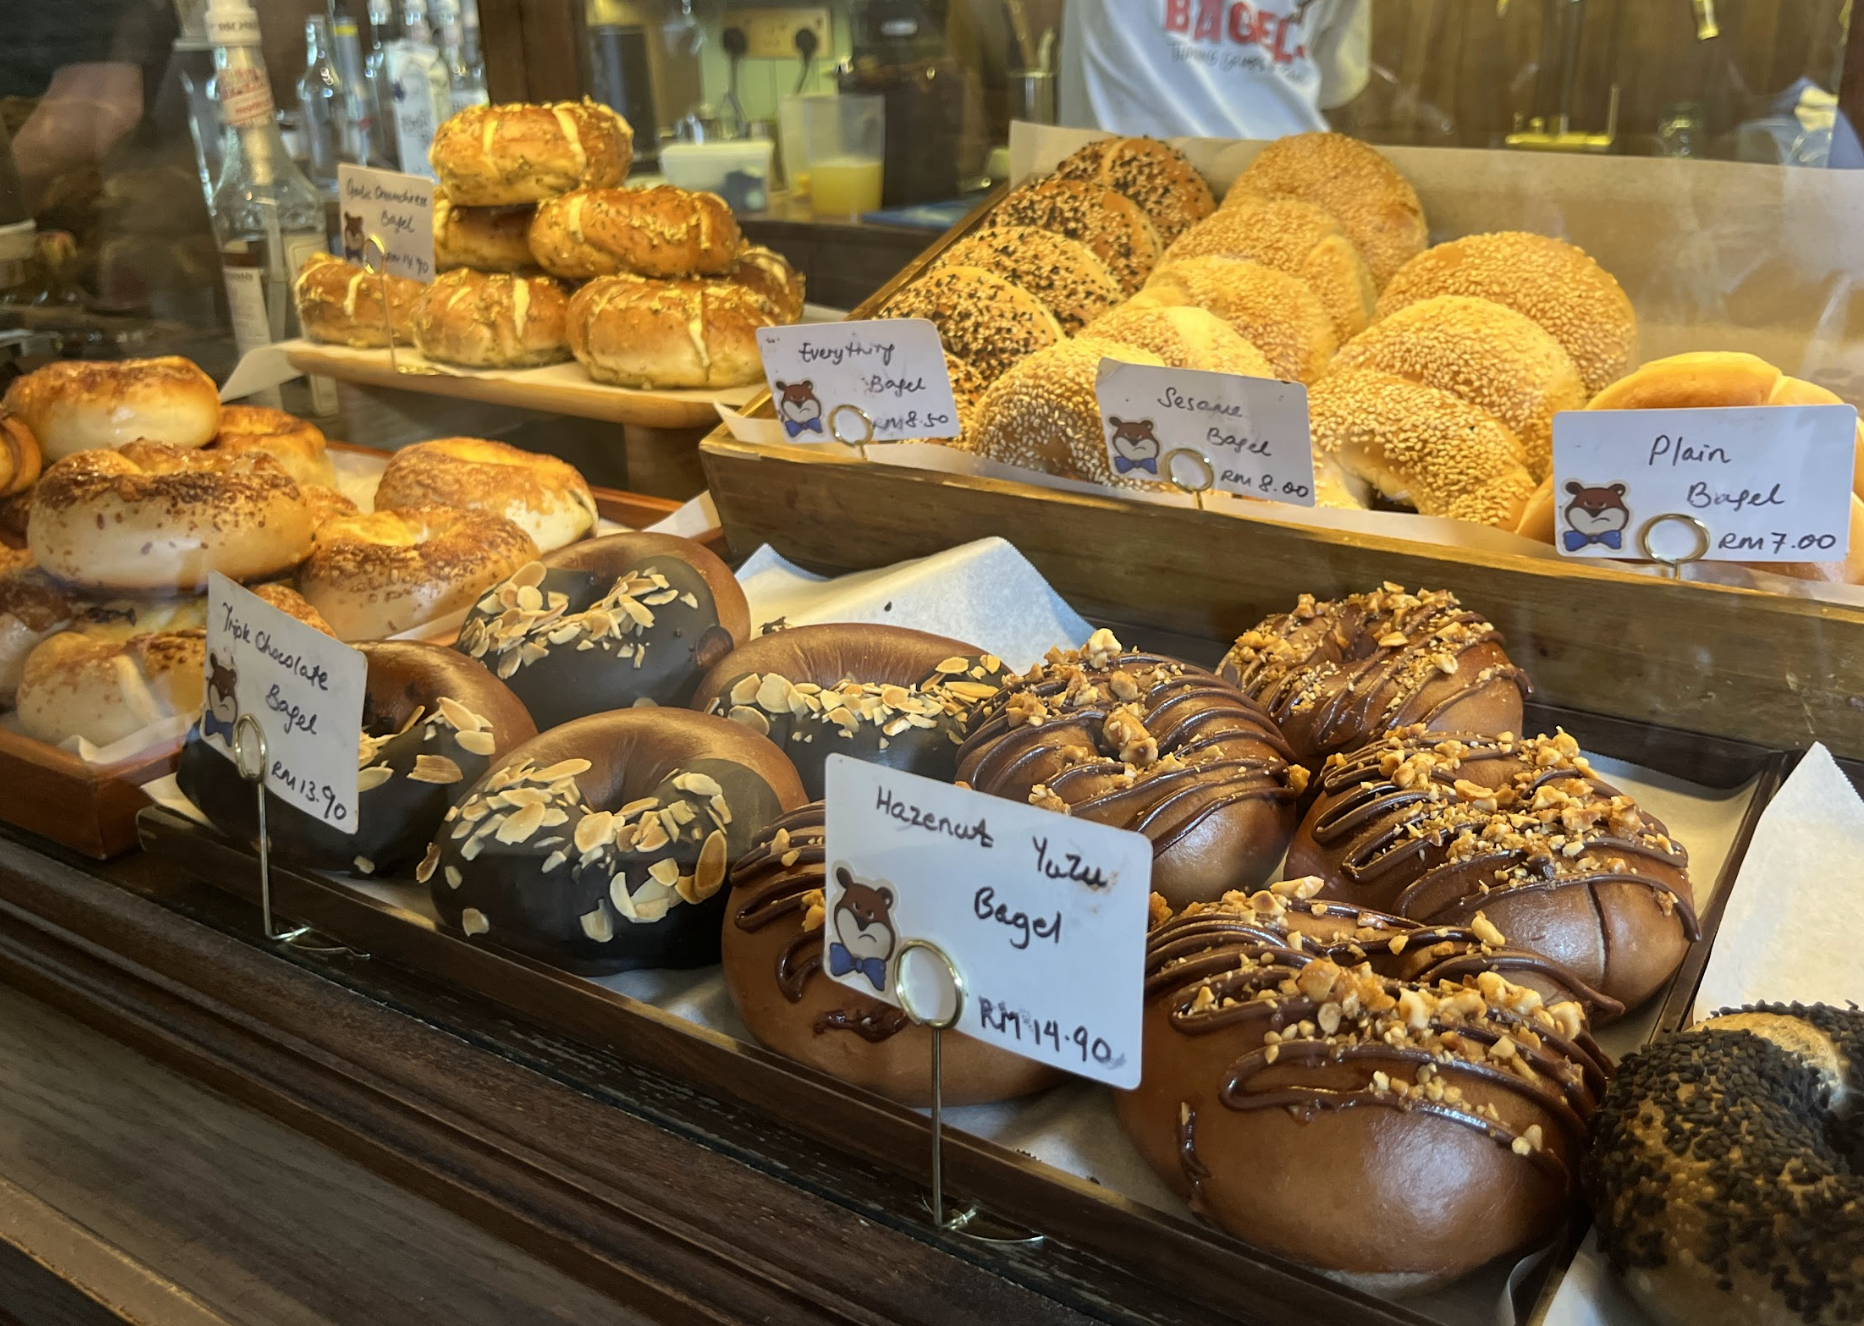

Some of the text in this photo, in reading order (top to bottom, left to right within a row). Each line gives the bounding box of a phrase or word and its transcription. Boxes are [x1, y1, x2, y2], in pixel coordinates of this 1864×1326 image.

[799, 342, 896, 366] Everything
[870, 374, 926, 397] Bagel
[1157, 387, 1243, 418] Sesame
[1206, 427, 1272, 457] Bagel
[1649, 434, 1731, 466] Plain
[1687, 482, 1785, 512] Bagel
[222, 602, 329, 691] Triple Chocolate
[265, 684, 317, 735] Bagel
